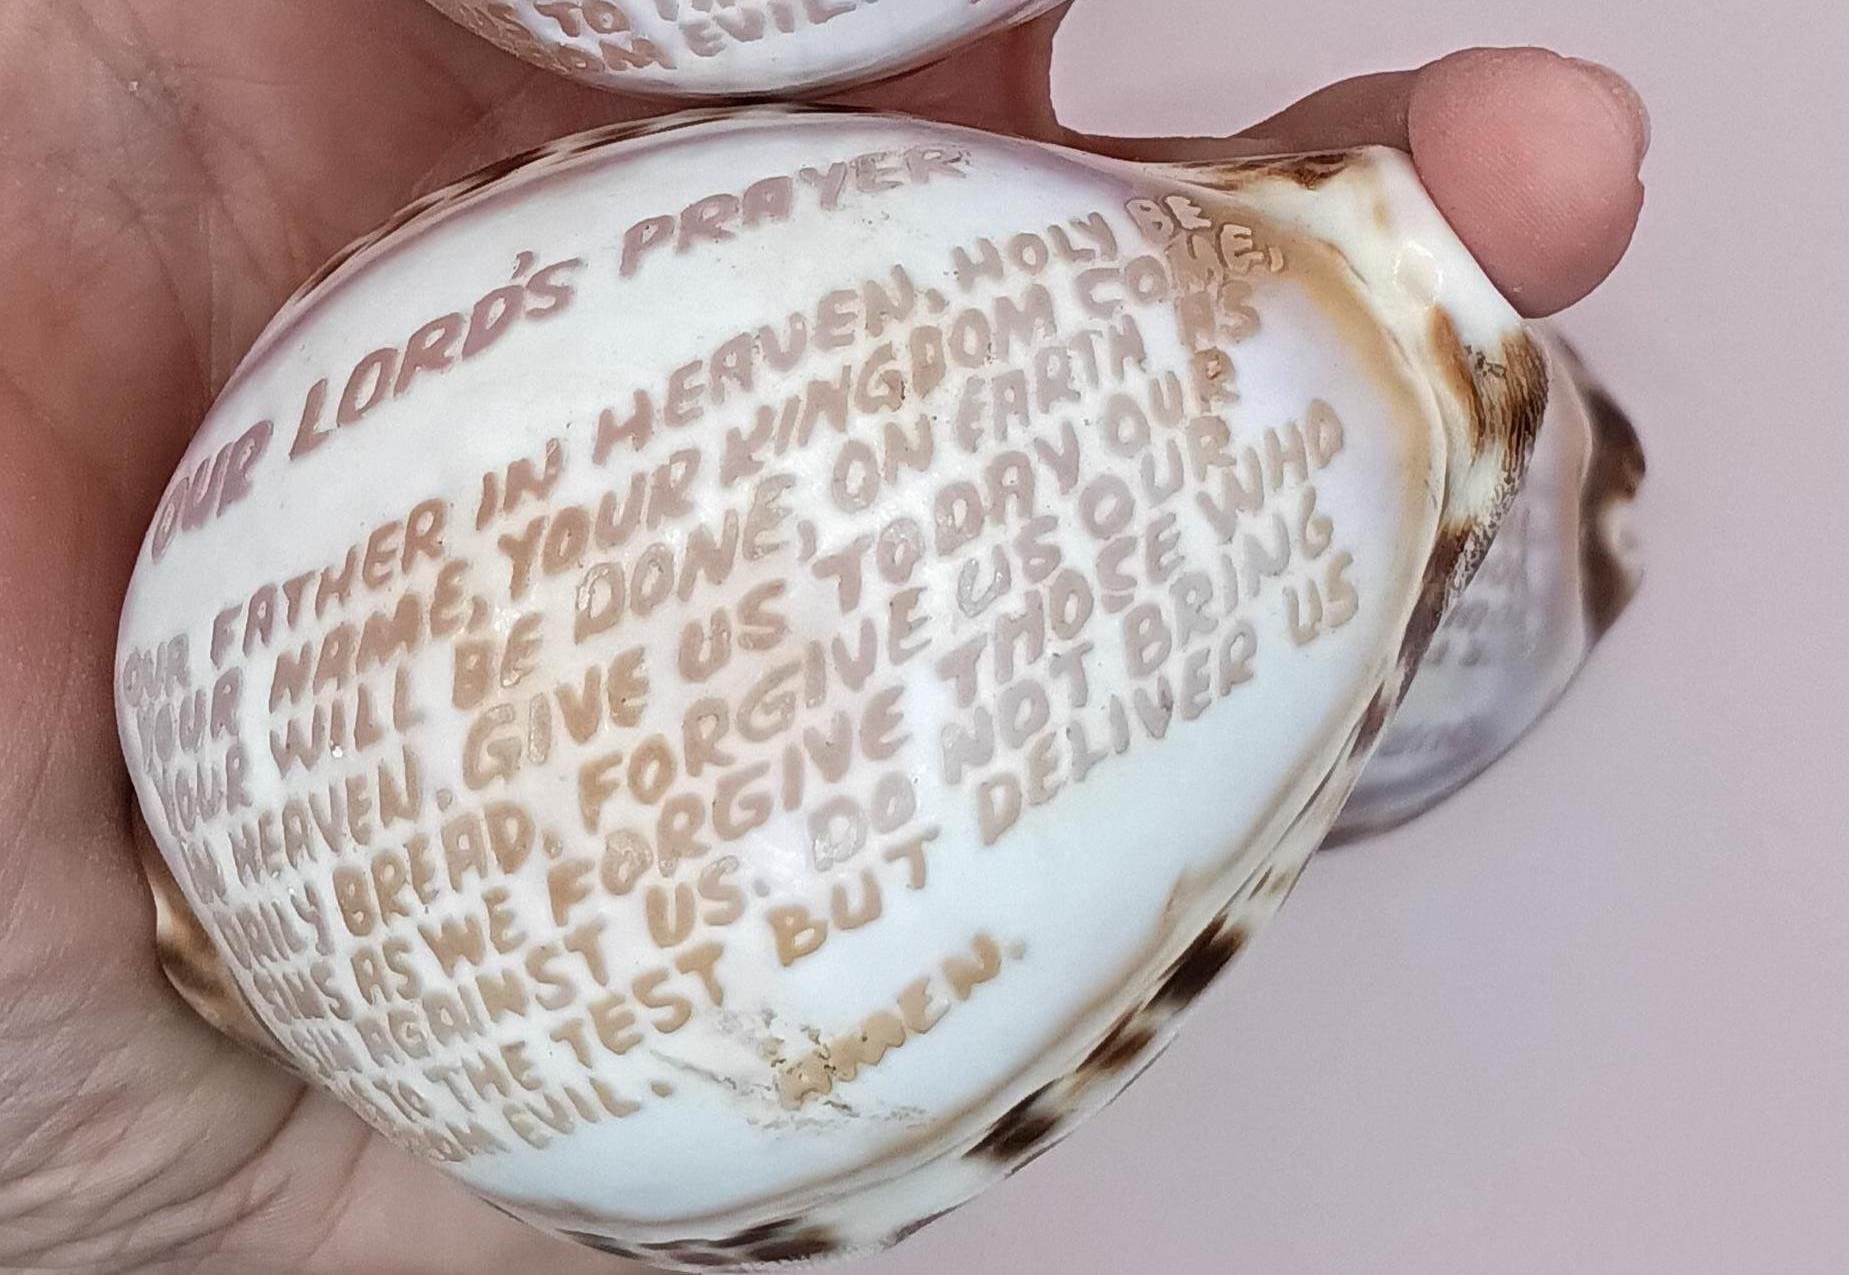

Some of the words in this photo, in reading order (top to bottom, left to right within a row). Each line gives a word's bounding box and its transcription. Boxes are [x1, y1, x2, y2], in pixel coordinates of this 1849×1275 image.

[532, 0, 631, 37] TO
[123, 632, 190, 708] OUR
[211, 497, 447, 668] FATHER
[475, 437, 565, 531] IN
[952, 212, 1118, 293] HOLY
[1125, 195, 1212, 242] BE
[137, 666, 241, 773] YOUR
[269, 558, 489, 714] NAME,
[498, 448, 701, 600] YOUR
[720, 283, 1057, 487] KINGDOM
[1074, 223, 1285, 320] COME,
[151, 421, 274, 564] OUR
[288, 250, 586, 462] LORD'S
[620, 147, 968, 278] PRAYER
[151, 742, 252, 838] YOUR
[269, 662, 424, 778] WILL
[452, 612, 544, 710] BE
[573, 474, 817, 645] DONE,
[831, 414, 934, 513] ON
[956, 314, 1147, 453] EARTH
[1175, 280, 1261, 352] AS
[462, 646, 650, 791] GIVE
[678, 577, 790, 683] US
[811, 420, 1080, 614] TODAY
[1104, 345, 1240, 459] OUR
[213, 881, 334, 969] DAILY
[332, 800, 563, 937] BREAD.
[578, 587, 931, 834] FORGIVE
[956, 514, 1062, 618] US
[1079, 415, 1237, 540] OUR
[254, 958, 352, 1025] SINS
[350, 936, 422, 1006] AS
[418, 886, 528, 978] WE
[547, 685, 909, 928] FORGIVE
[937, 511, 1185, 709] THOSE
[1195, 398, 1344, 544] WHO
[354, 921, 608, 1068] AGAINST
[645, 854, 771, 948] US.
[810, 769, 917, 872] DO
[939, 639, 1095, 786] NOT
[1123, 484, 1334, 677] BRING
[372, 1079, 433, 1123] TO
[422, 1039, 543, 1113] THE
[550, 940, 724, 1069] TEST
[765, 826, 940, 968] BUT
[977, 620, 1258, 845] DELIVER
[1282, 550, 1359, 646] US
[502, 1076, 673, 1150] EVIL.
